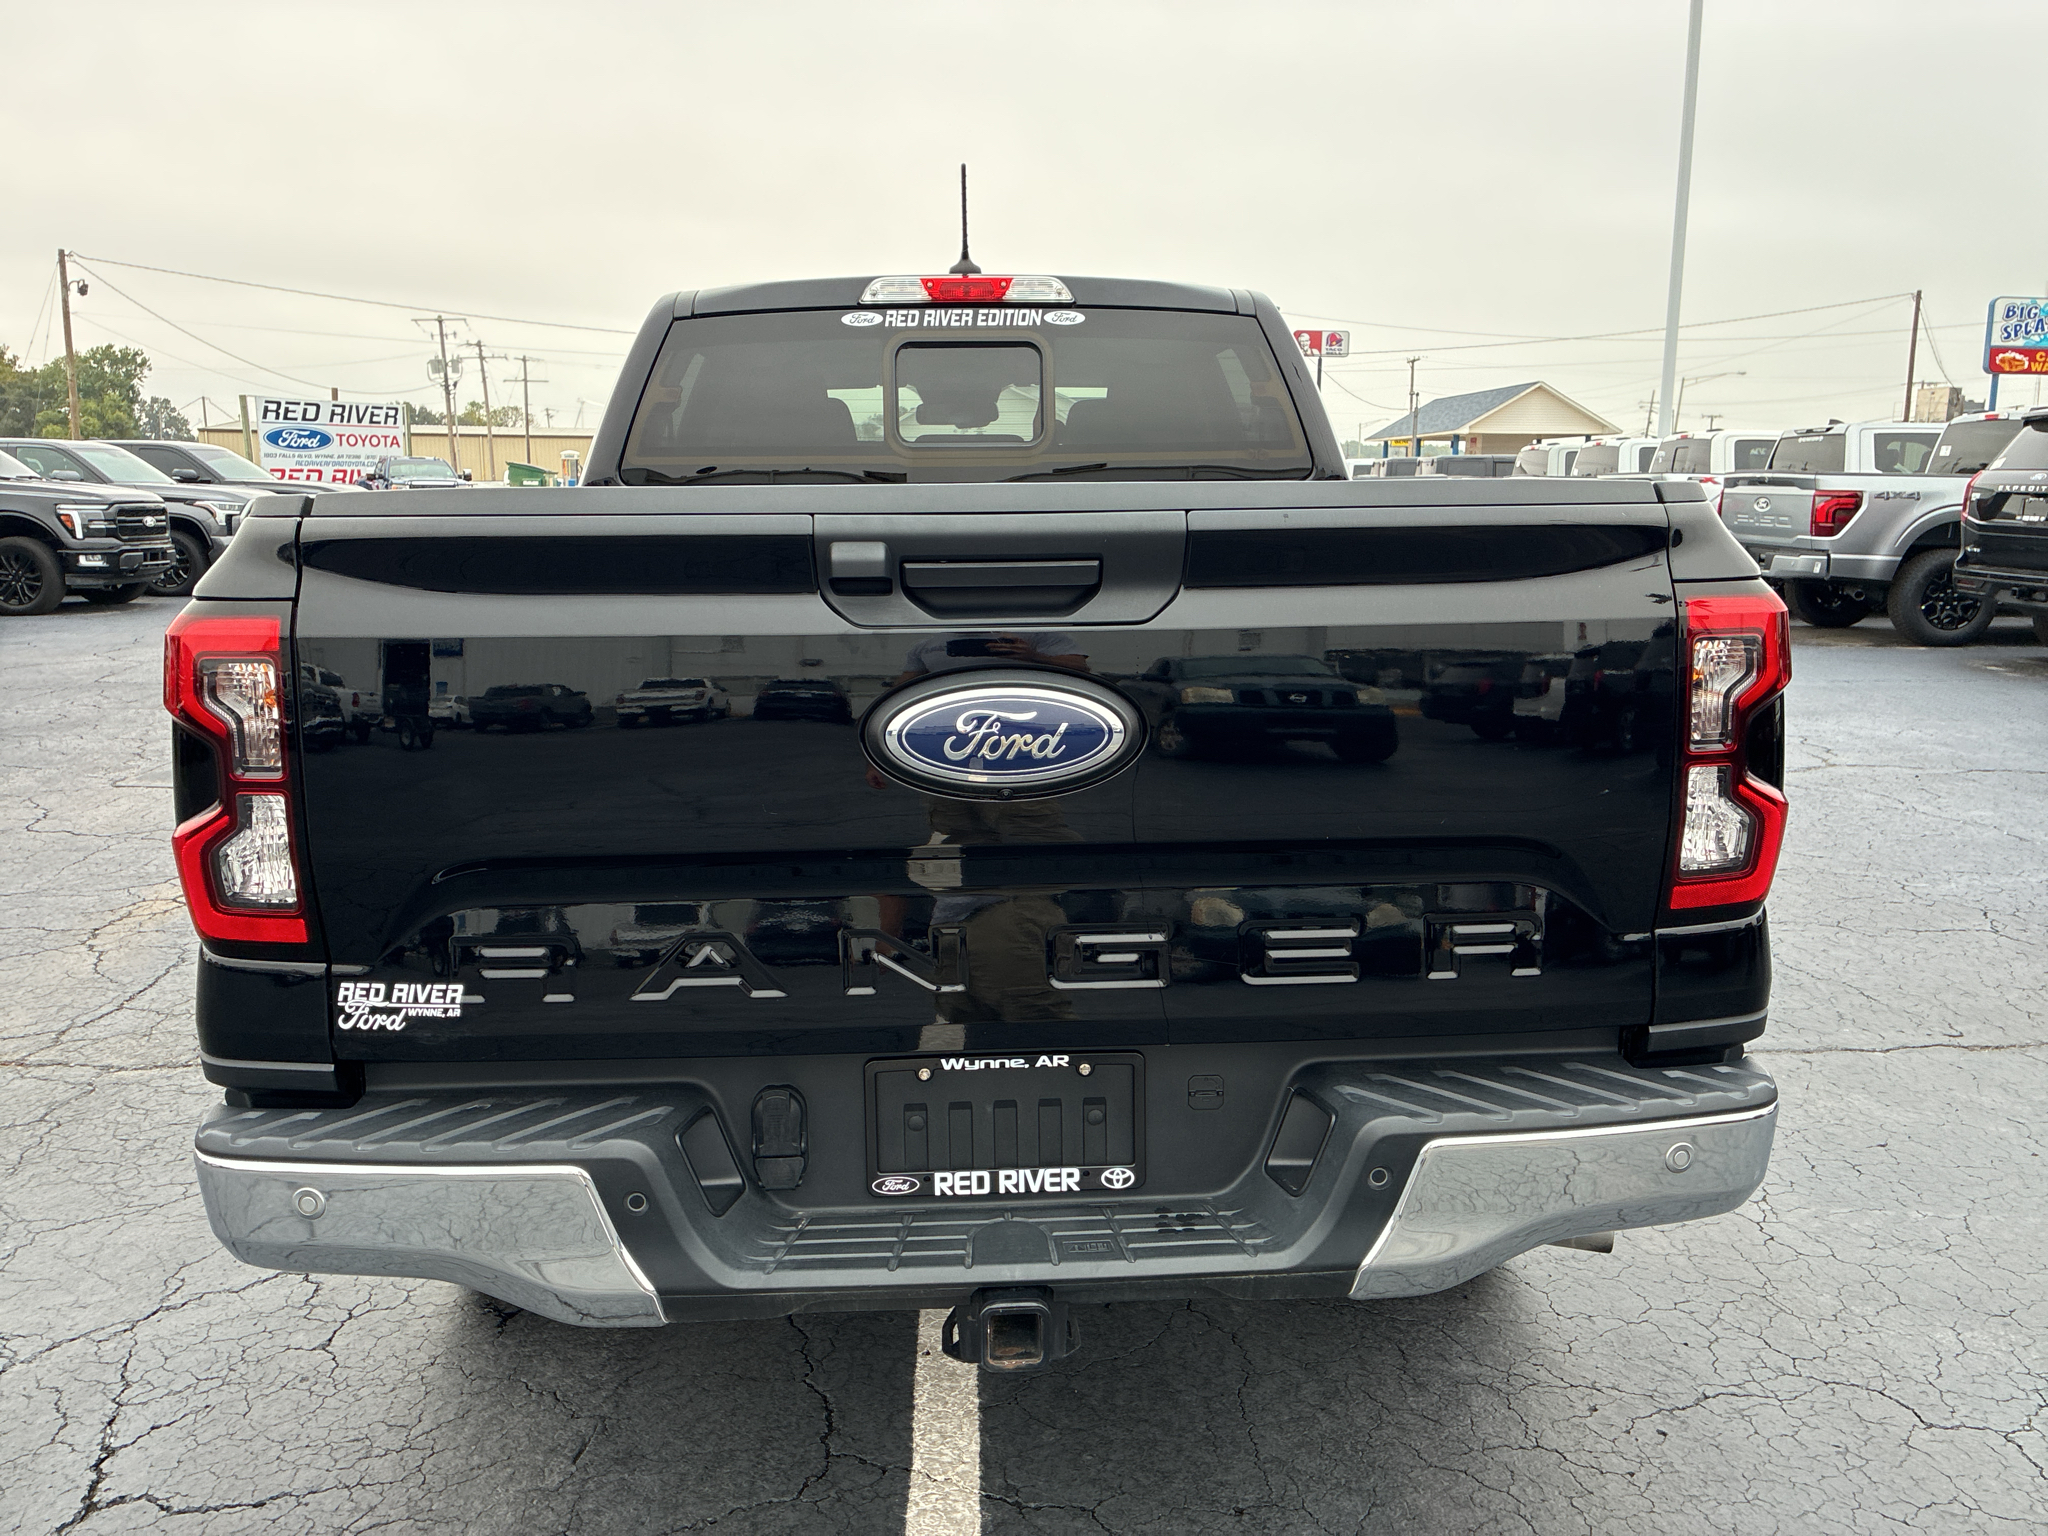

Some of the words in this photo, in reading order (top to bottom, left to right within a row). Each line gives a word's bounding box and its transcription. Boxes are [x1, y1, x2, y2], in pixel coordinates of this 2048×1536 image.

[885, 310, 919, 327] RED
[923, 309, 973, 327] RIVER
[977, 309, 1042, 326] EDITION
[2004, 303, 2040, 320] BIG
[2002, 318, 2048, 341] SPLA
[261, 400, 321, 422] RED
[329, 403, 399, 425] RIVER
[277, 429, 321, 448] Ford
[336, 433, 401, 448] TOYOTA
[943, 709, 1069, 760] Ford
[449, 908, 1544, 1003] RANGER
[337, 982, 386, 1003] RED
[391, 983, 464, 1004] RIVER
[337, 1000, 406, 1031] Ford
[407, 1008, 446, 1018] WYNNE,
[447, 1008, 461, 1017] AR
[940, 1057, 1030, 1071] Wynne,
[1035, 1055, 1070, 1068] AR
[880, 1179, 911, 1192] Ford
[934, 1170, 990, 1196] RED
[998, 1167, 1081, 1194] RIVER
